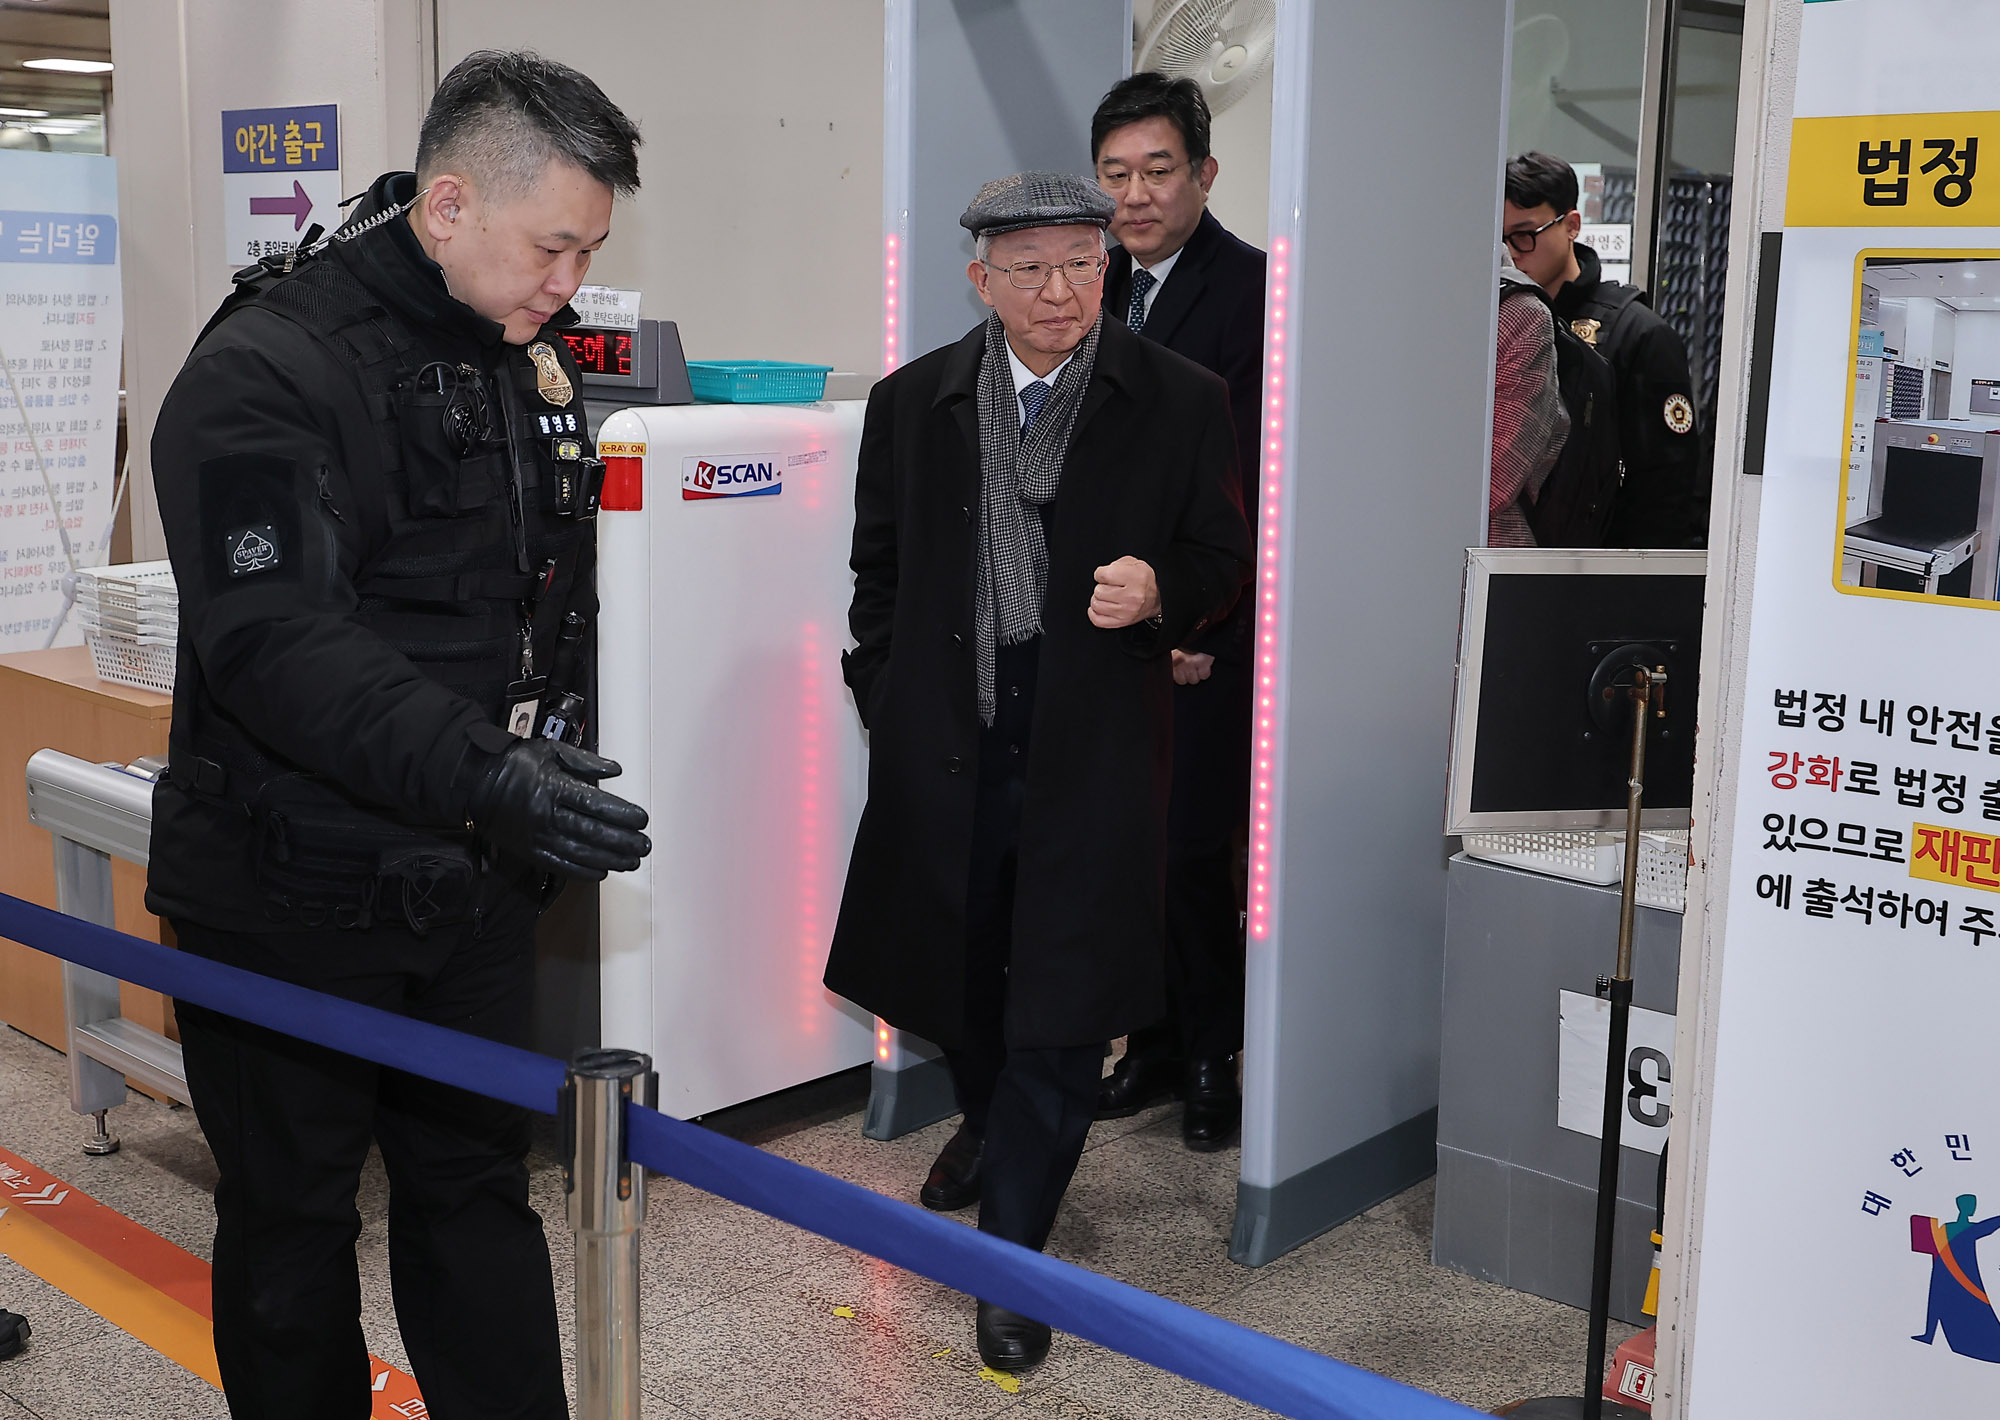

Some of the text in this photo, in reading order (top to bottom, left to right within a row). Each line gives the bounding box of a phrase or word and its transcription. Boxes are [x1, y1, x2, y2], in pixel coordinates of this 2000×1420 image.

[235, 120, 325, 165] 야간 출구
[1857, 137, 1979, 208] 법정
[247, 240, 260, 257] 2층
[593, 311, 636, 326] 부탁드립니다.
[601, 444, 643, 453] X-RAY ON
[1774, 688, 1847, 732] 법정
[1859, 698, 1895, 737] 내
[1767, 751, 1880, 796] 강화로
[1893, 766, 1967, 814] 법정
[1762, 813, 1905, 864] 있으므로
[1756, 874, 2000, 947] 에 출석하여 주
